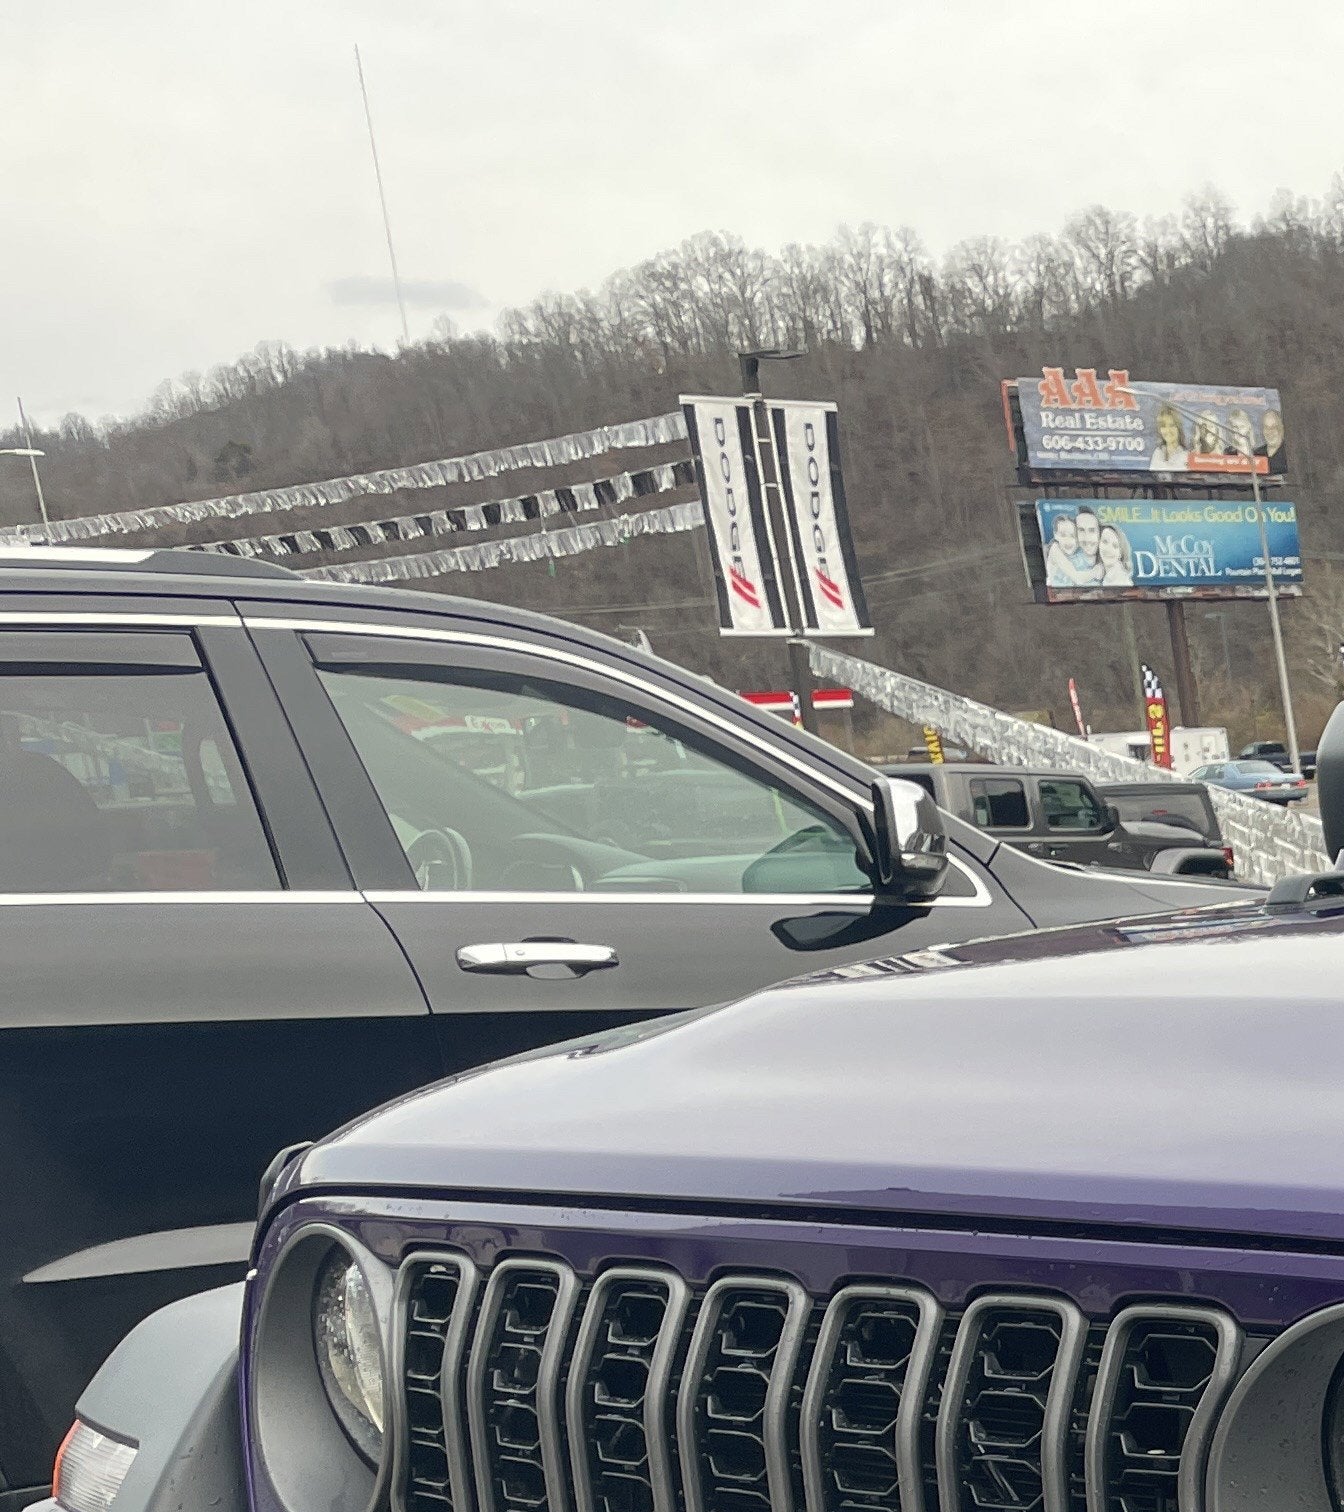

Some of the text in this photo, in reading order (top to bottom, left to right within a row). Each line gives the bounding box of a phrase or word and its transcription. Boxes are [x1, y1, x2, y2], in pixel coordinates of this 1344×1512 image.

[1038, 367, 1140, 411] AAA
[1040, 411, 1144, 430] Real Estate
[1042, 435, 1145, 451] 606-433-9700
[712, 416, 748, 582] DODGE
[804, 421, 833, 582] DODGE
[1162, 506, 1202, 523] Looks
[1204, 505, 1243, 523] Good
[1266, 506, 1296, 523] You!
[1133, 551, 1222, 577] DENTAL
